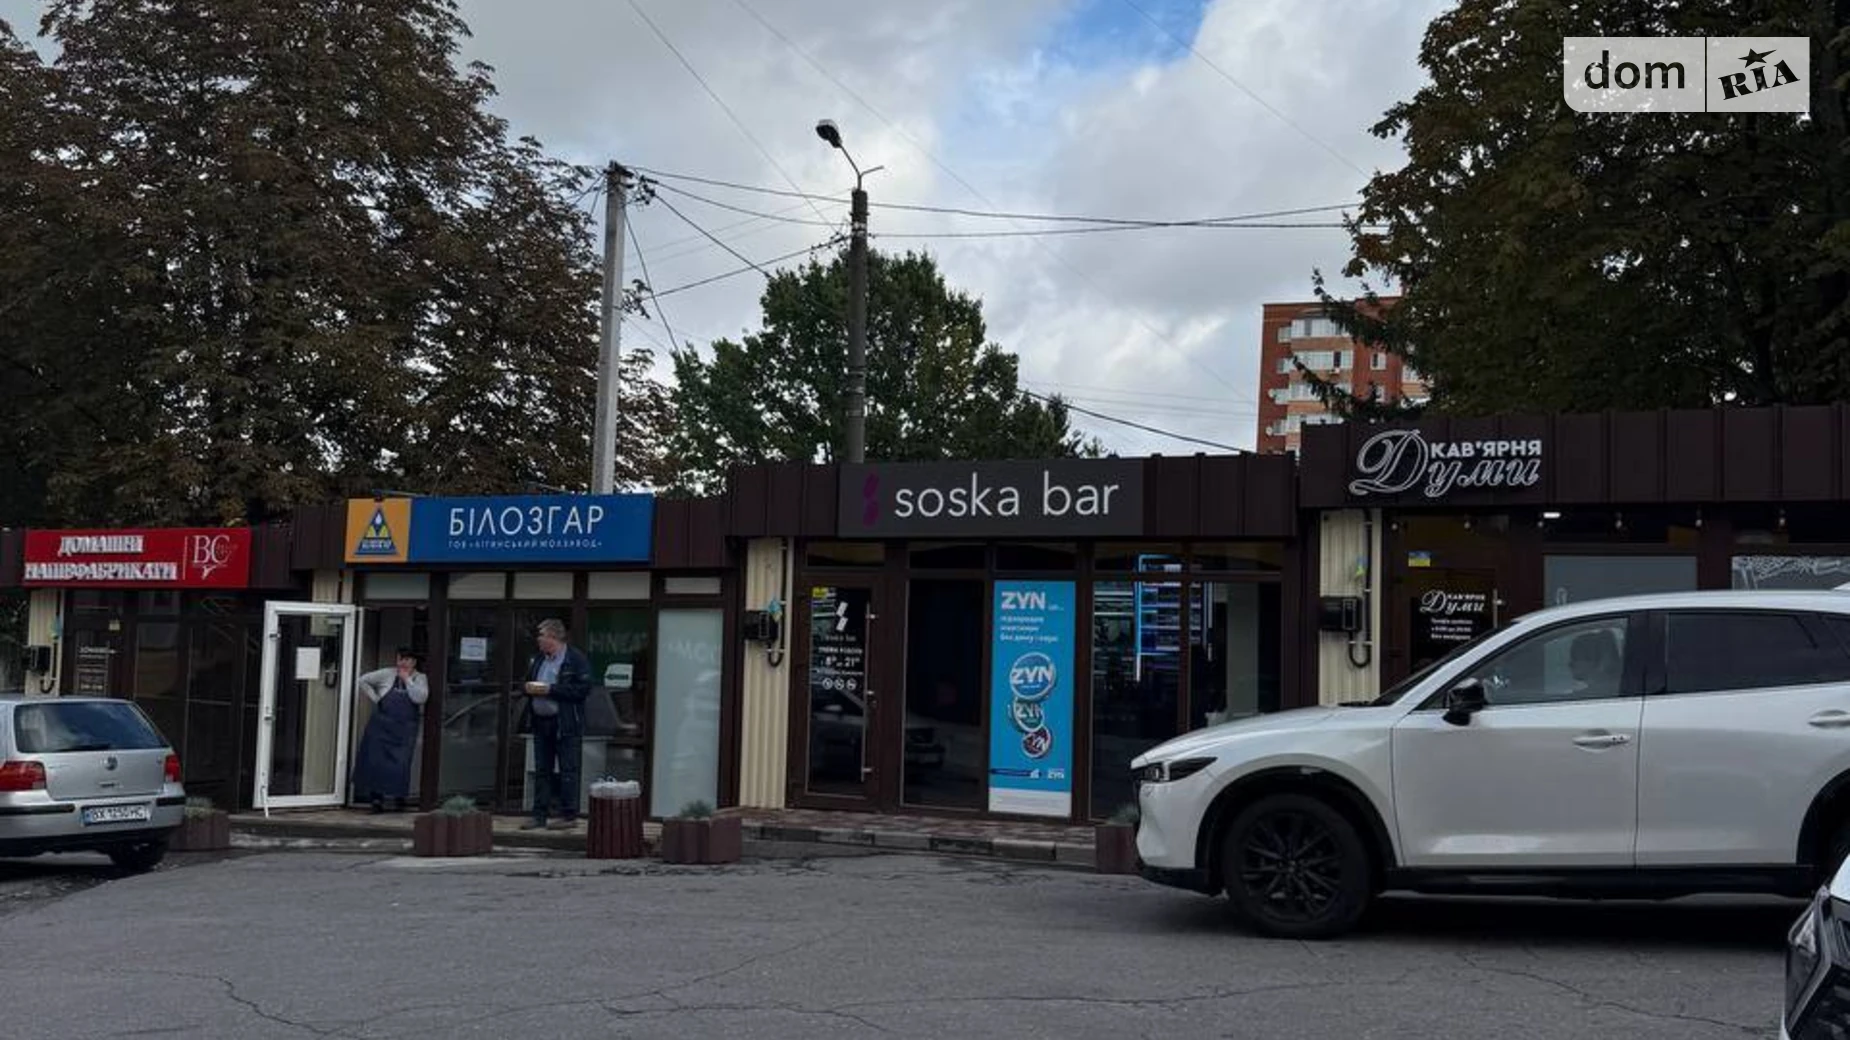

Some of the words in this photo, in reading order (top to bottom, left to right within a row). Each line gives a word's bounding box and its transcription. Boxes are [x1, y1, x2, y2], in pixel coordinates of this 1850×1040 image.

[1430, 440, 1542, 458] КАВ'ЯРНЯ
[1349, 429, 1541, 497] Думи
[895, 472, 1019, 517] soska
[1043, 470, 1119, 515] bar
[450, 506, 603, 536] БІЛОЗГАР
[1001, 591, 1045, 609] ZYN
[1012, 666, 1051, 684] ZYN
